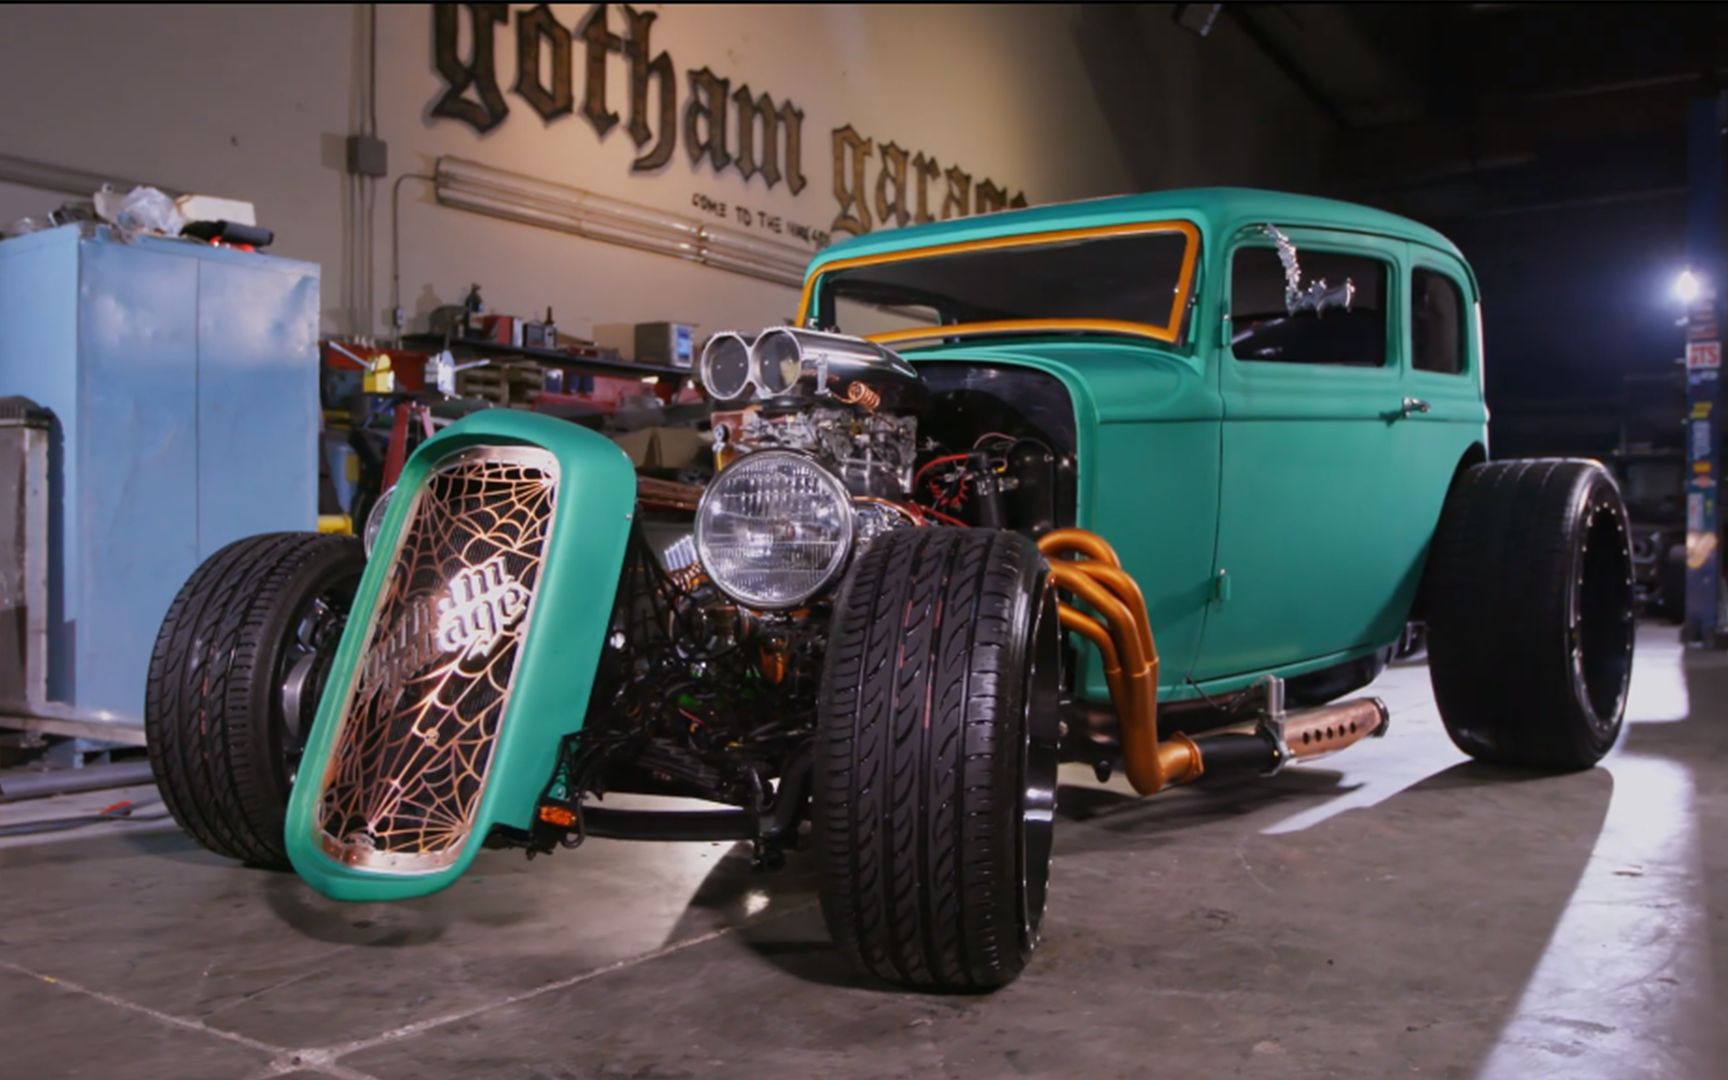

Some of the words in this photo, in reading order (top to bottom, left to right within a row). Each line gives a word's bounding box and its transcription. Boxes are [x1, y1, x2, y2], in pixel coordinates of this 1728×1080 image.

[691, 193, 727, 218] COME
[735, 205, 751, 227] TO
[757, 211, 782, 234] THE
